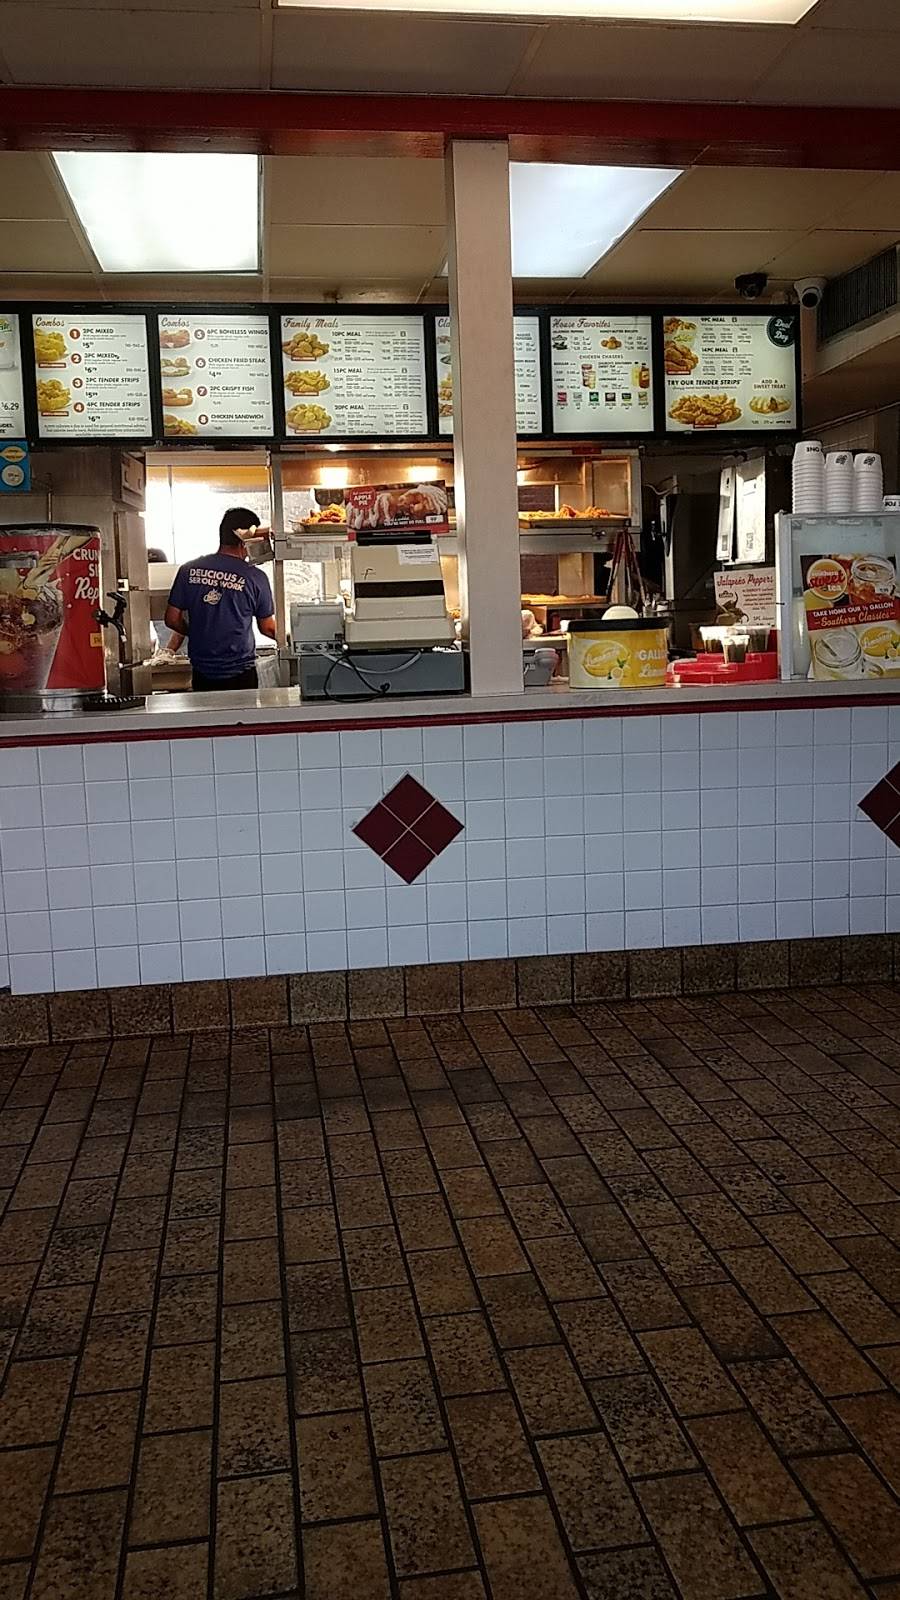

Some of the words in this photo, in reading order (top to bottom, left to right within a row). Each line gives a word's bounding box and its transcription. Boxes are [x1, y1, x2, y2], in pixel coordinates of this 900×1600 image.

[36, 317, 65, 327] Combos
[161, 317, 190, 327] Combos
[283, 317, 311, 331] Family
[315, 317, 339, 329] Meals
[552, 318, 575, 329] House
[577, 318, 611, 328] Favorites
[189, 568, 238, 582] DELICIOUS
[747, 574, 774, 587] Peppers
[808, 570, 846, 589] sweet
[220, 581, 245, 592] WORK
[827, 584, 842, 592] tea
[828, 608, 847, 616] HOME
[869, 601, 894, 610] GALLON
[820, 615, 856, 628] Southern
[858, 610, 890, 622] Classics
